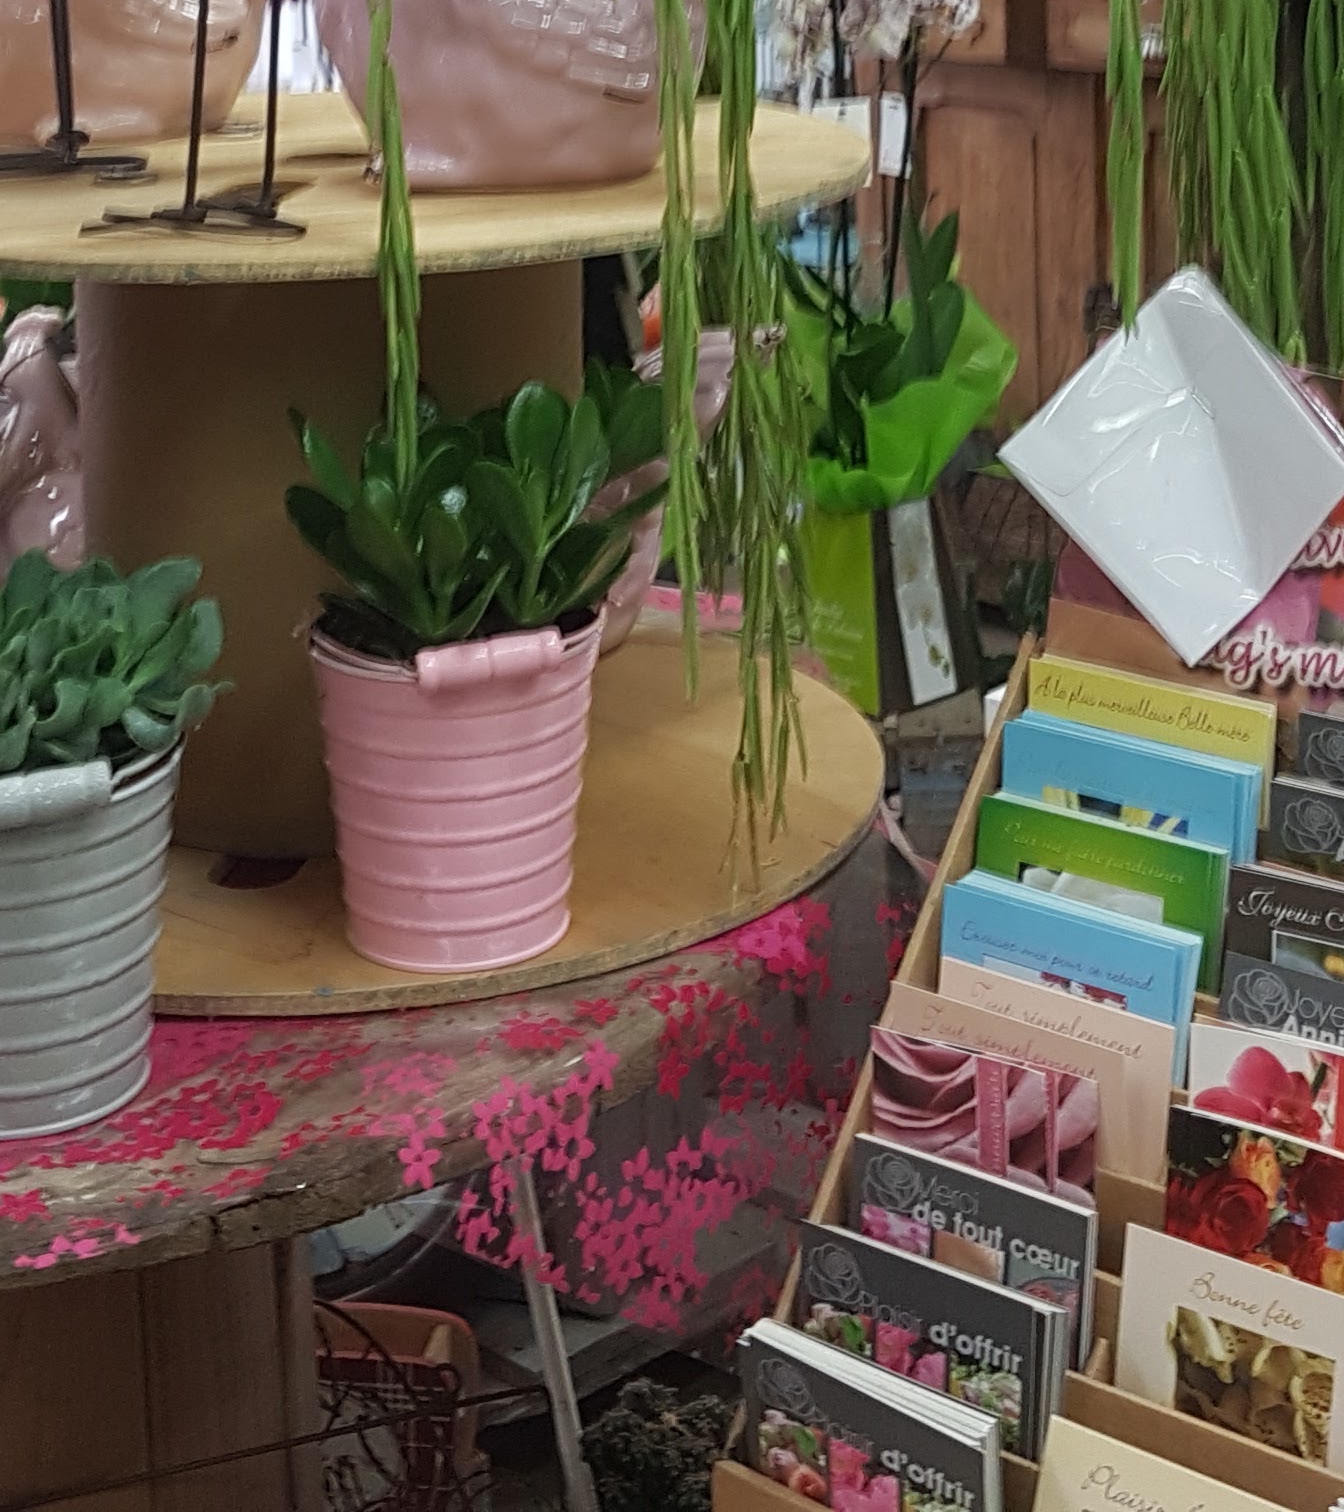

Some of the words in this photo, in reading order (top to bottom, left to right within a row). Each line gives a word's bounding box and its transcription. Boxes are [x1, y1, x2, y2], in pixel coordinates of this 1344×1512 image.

[1237, 887, 1321, 928] Joyeux
[912, 1201, 946, 1231] de
[951, 1212, 1004, 1251] tout
[1189, 1270, 1259, 1316] Bonne
[1261, 1298, 1307, 1331] fête
[929, 1321, 1024, 1375] d'offrir
[879, 1448, 976, 1509] d'offrir
